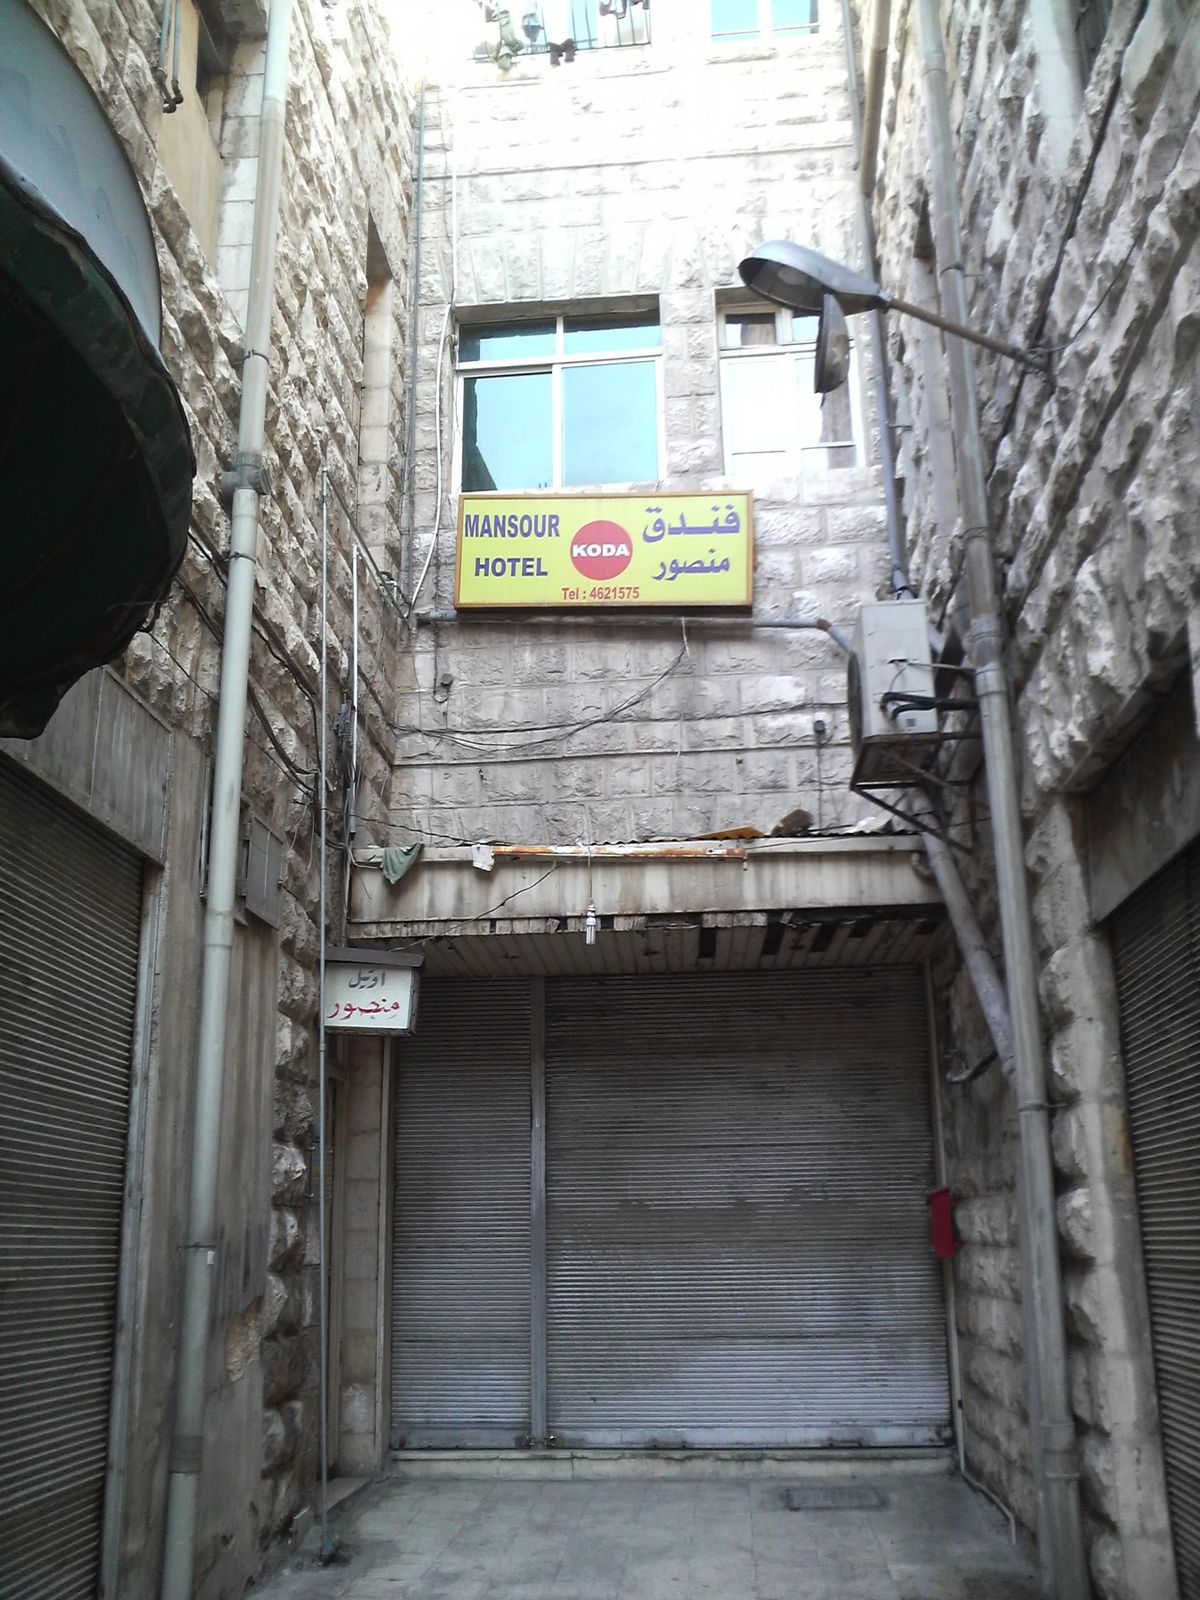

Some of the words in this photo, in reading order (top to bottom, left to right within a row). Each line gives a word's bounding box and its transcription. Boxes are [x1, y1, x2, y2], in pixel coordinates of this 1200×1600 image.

[464, 514, 560, 538] MANSOUR
[642, 504, 741, 543] فندق
[572, 543, 629, 558] KODA
[474, 557, 548, 577] HOTEL
[652, 548, 730, 581] منصور
[589, 586, 640, 600] 4621575
[327, 998, 400, 1021] منصور
